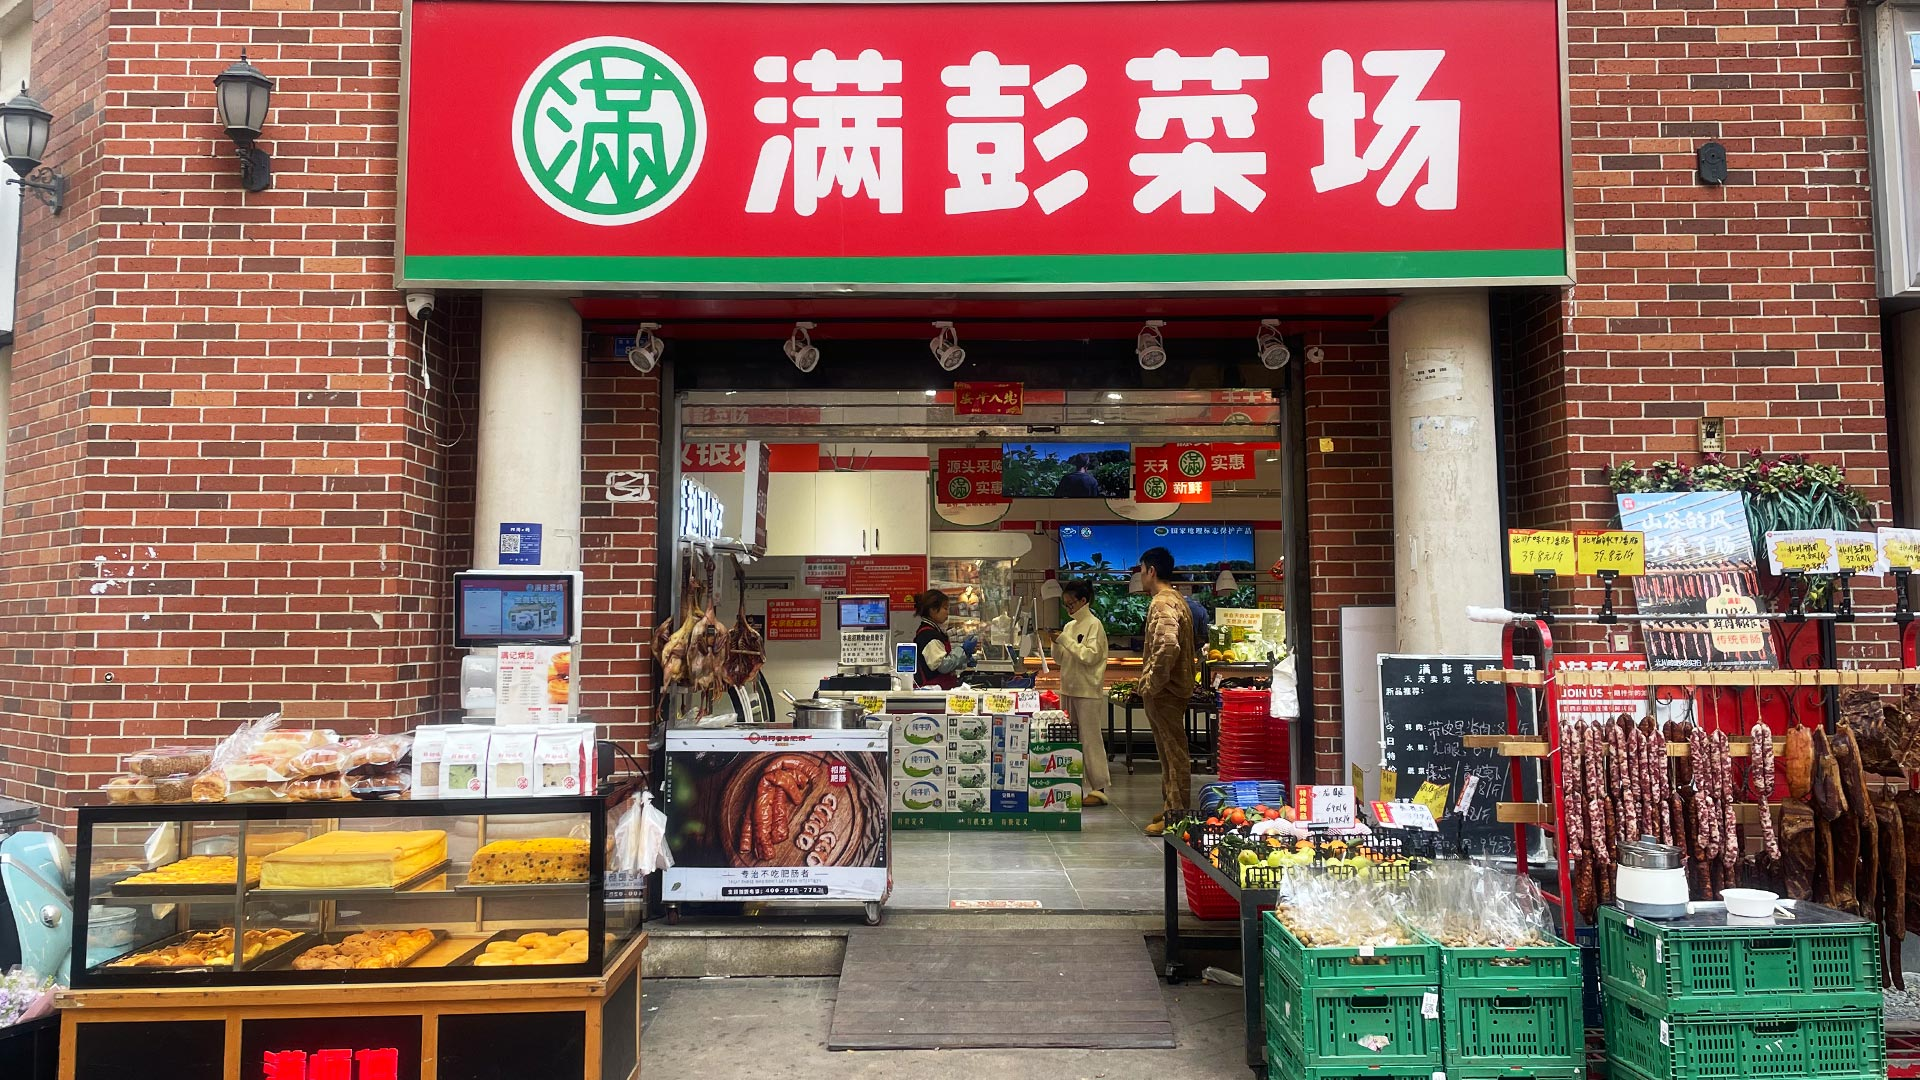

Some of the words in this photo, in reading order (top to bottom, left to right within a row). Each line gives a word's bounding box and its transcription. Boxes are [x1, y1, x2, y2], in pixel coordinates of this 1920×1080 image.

[745, 48, 1461, 216] 满彭菜场
[947, 459, 1003, 474] 源头采购
[1211, 454, 1245, 471] 实惠
[976, 480, 1003, 496] 实惠
[1173, 481, 1203, 495] 新鲜
[1641, 508, 1733, 531] 山谷的风
[1170, 527, 1252, 535] 国家地理标志保护产品
[1716, 634, 1761, 645] 传统香肠
[1404, 675, 1452, 684] 天天卖完
[1385, 687, 1424, 696] 新品推荐：
[1561, 688, 1587, 698] JOIN
[1589, 688, 1604, 698] US
[912, 723, 932, 731] 纯牛奶
[1406, 743, 1429, 752] 水果：
[911, 755, 931, 764] 纯牛奶
[830, 765, 847, 775] 招牌
[830, 774, 847, 783] 肥肠
[911, 788, 931, 796] 纯牛奶
[1298, 789, 1308, 821] 特价商品
[741, 869, 810, 878] 专治不吃肥肠者
